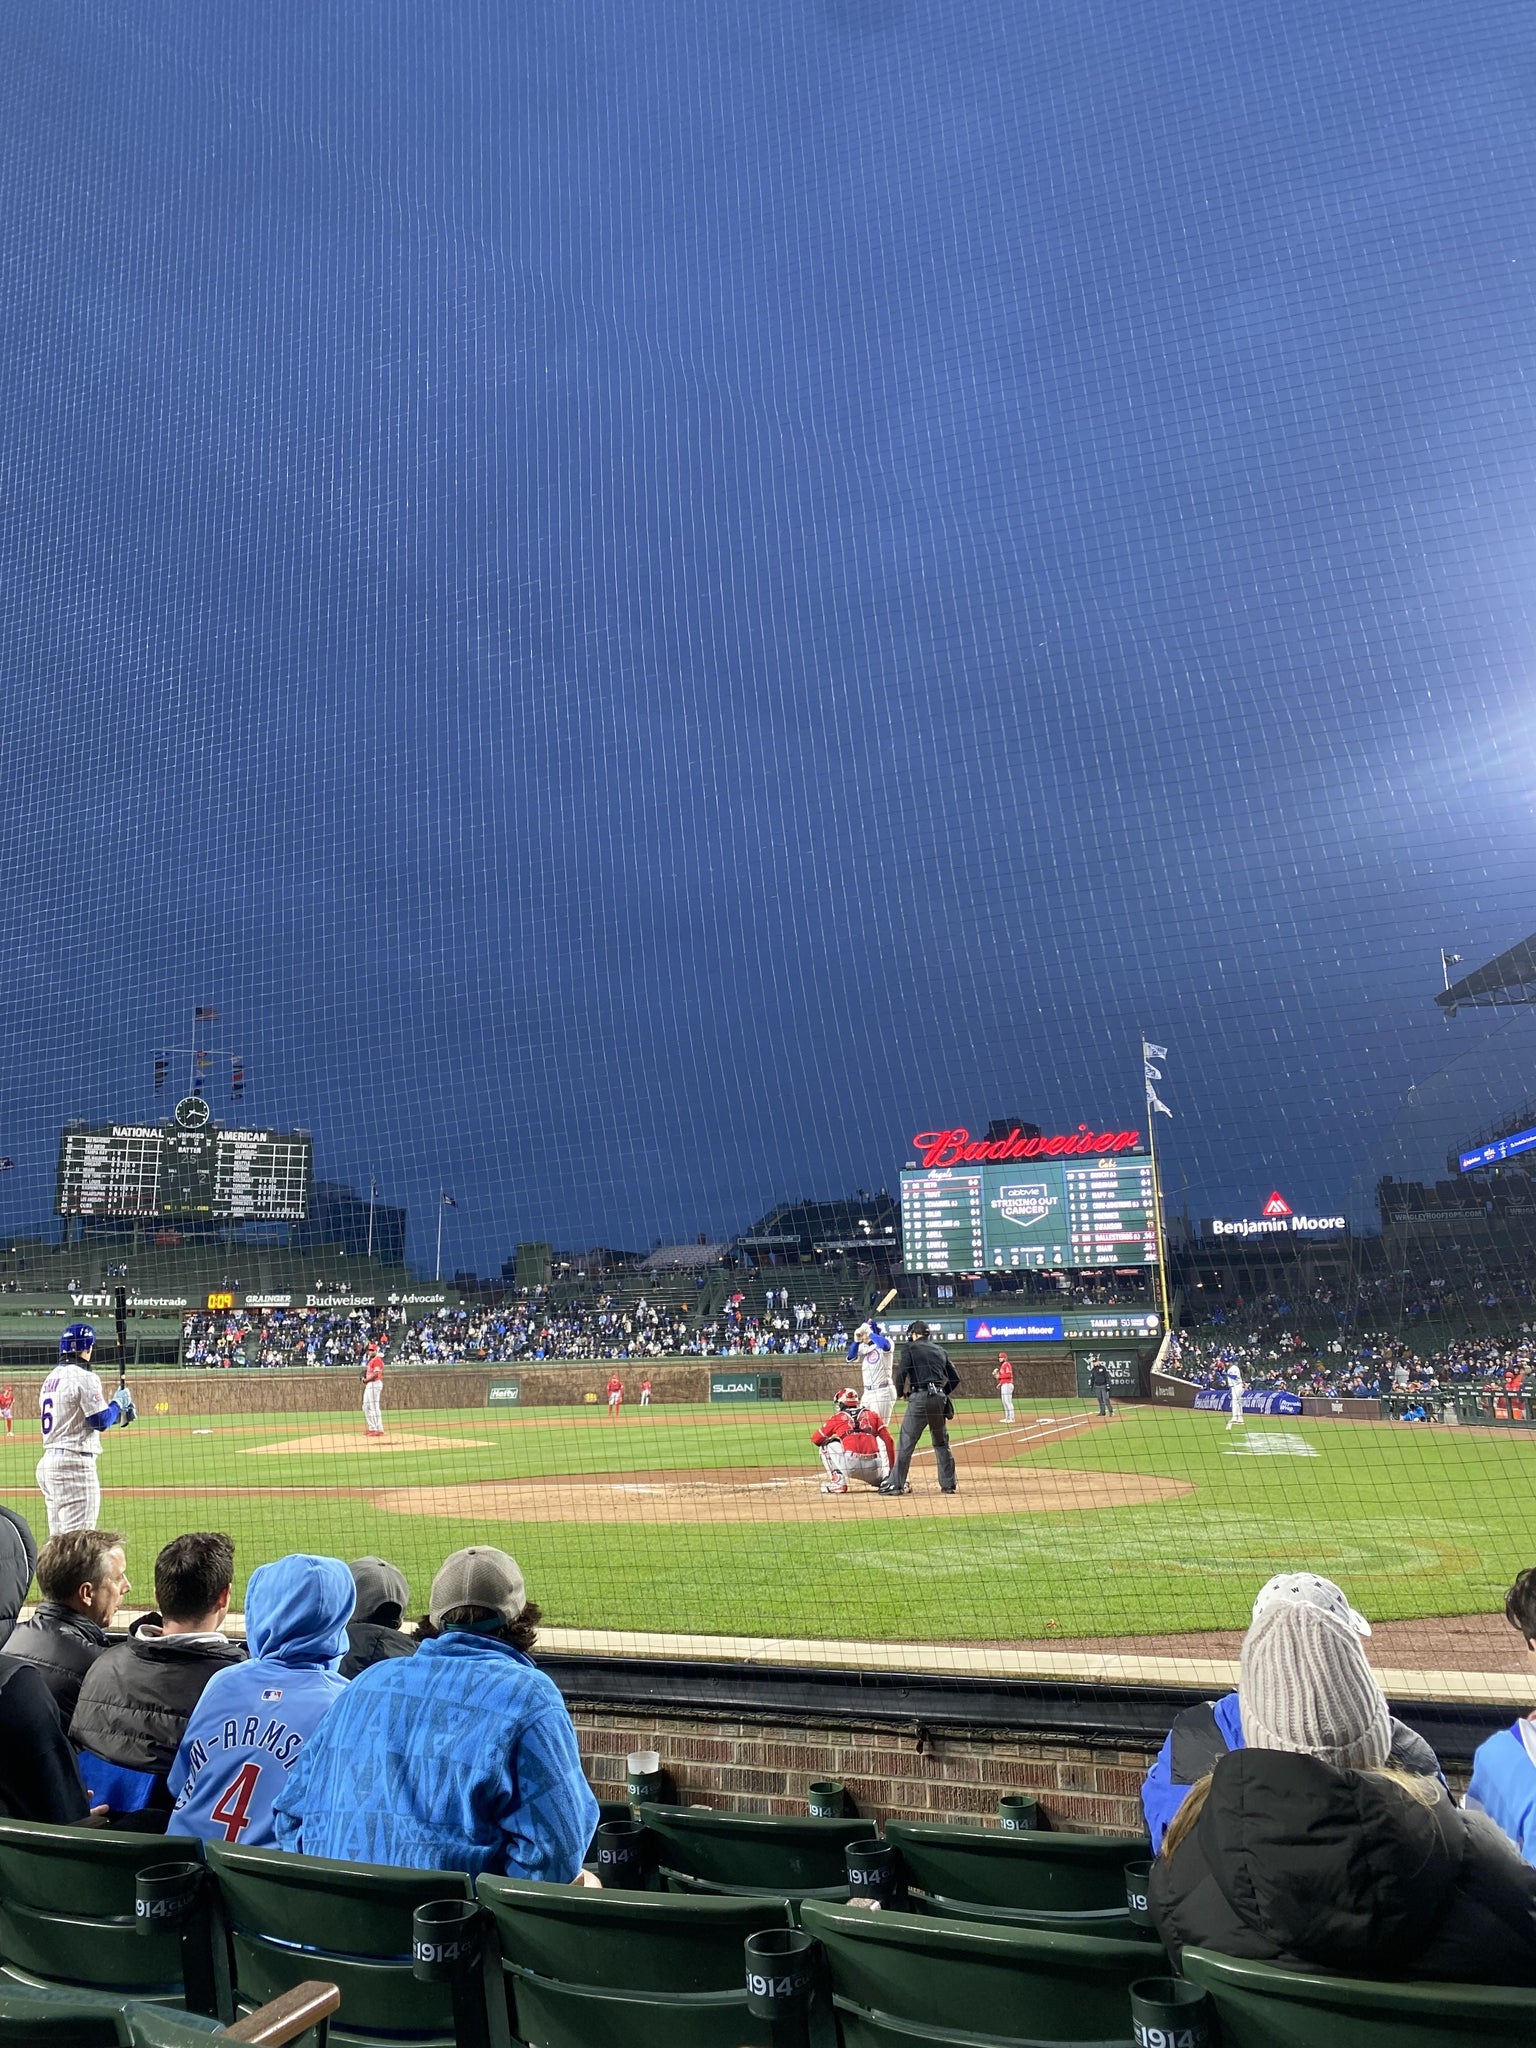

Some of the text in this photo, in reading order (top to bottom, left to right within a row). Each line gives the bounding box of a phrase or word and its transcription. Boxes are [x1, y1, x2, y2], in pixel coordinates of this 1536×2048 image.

[112, 1126, 164, 1138] NATIONAL
[217, 1131, 267, 1142] AMERICAN
[913, 1124, 1139, 1168] Budweiser
[181, 1155, 197, 1164] 25
[1098, 1159, 1117, 1168] Cubs
[928, 1167, 953, 1179] Angels
[199, 1174, 206, 1184] 2
[991, 1197, 1058, 1208] STRIKING OUT
[1005, 1206, 1045, 1215] CANCER
[1394, 1210, 1483, 1221] WRIGLEYROOFTOPS.COM
[1212, 1216, 1345, 1236] Benjamin Moore
[1096, 1245, 1113, 1253] SHAW
[994, 1255, 1003, 1266] 4
[1011, 1255, 1019, 1265] 2
[1036, 1254, 1044, 1264] 2
[1053, 1253, 1062, 1264] 4
[1097, 1255, 1118, 1263] AMAYA
[71, 1294, 111, 1306] YETI
[133, 1297, 187, 1306] tastytrade
[207, 1293, 233, 1309] 0:09
[245, 1295, 292, 1303] GRAINGER
[401, 1294, 445, 1304] Advocate
[1090, 1319, 1118, 1327] TAILLON
[991, 1326, 1027, 1337] Benjamin
[1028, 1326, 1053, 1335] Moore
[41, 1397, 54, 1434] 6
[210, 1762, 263, 1843] 4
[809, 1804, 832, 1817] 1914
[1003, 1818, 1029, 1830] 1914
[599, 1848, 629, 1864] 1914
[848, 1868, 881, 1885] 1914
[1131, 1893, 1148, 1911] 19
[416, 1941, 461, 1963] 1914
[748, 1972, 793, 1998] 1914
[1141, 2026, 1195, 2048] 1914
